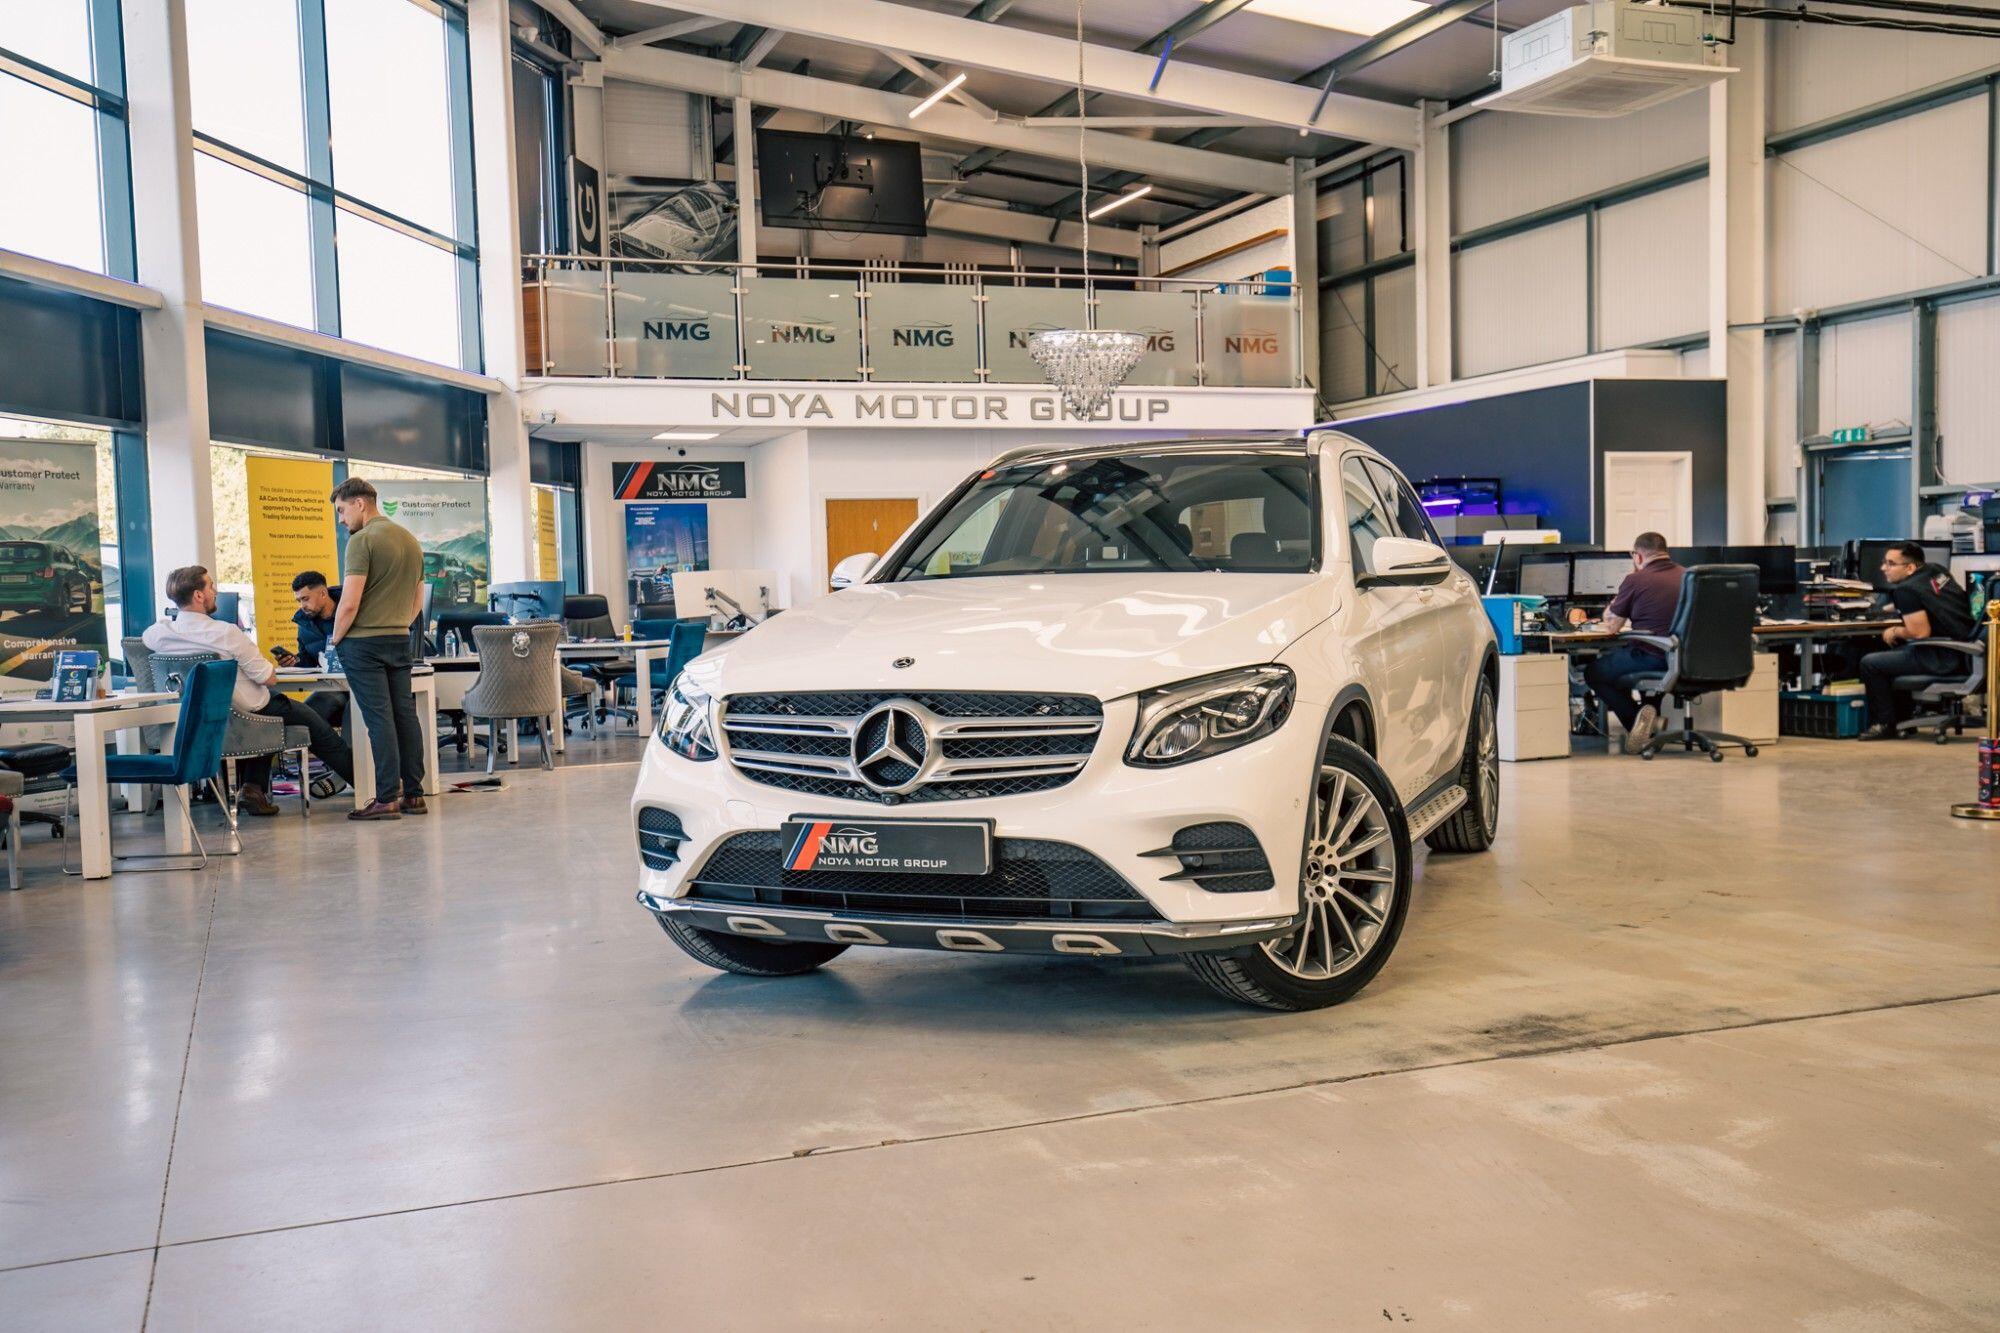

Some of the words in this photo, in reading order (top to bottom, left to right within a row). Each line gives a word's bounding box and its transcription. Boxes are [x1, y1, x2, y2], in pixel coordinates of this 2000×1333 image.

[642, 320, 710, 341] NMG
[771, 324, 835, 344] NMG
[893, 328, 954, 347] NMG
[1225, 337, 1279, 354] NMG
[711, 392, 834, 419] NOYA
[855, 394, 1008, 421] MOTOR
[0, 469, 42, 479] ustomer
[44, 470, 80, 480] Protect
[657, 473, 721, 491] NMG
[4, 637, 76, 648] Comprehensive
[817, 836, 879, 855] NMG
[818, 856, 851, 866] NOYA
[855, 857, 899, 867] MOTOR
[903, 858, 948, 868] GROUP
